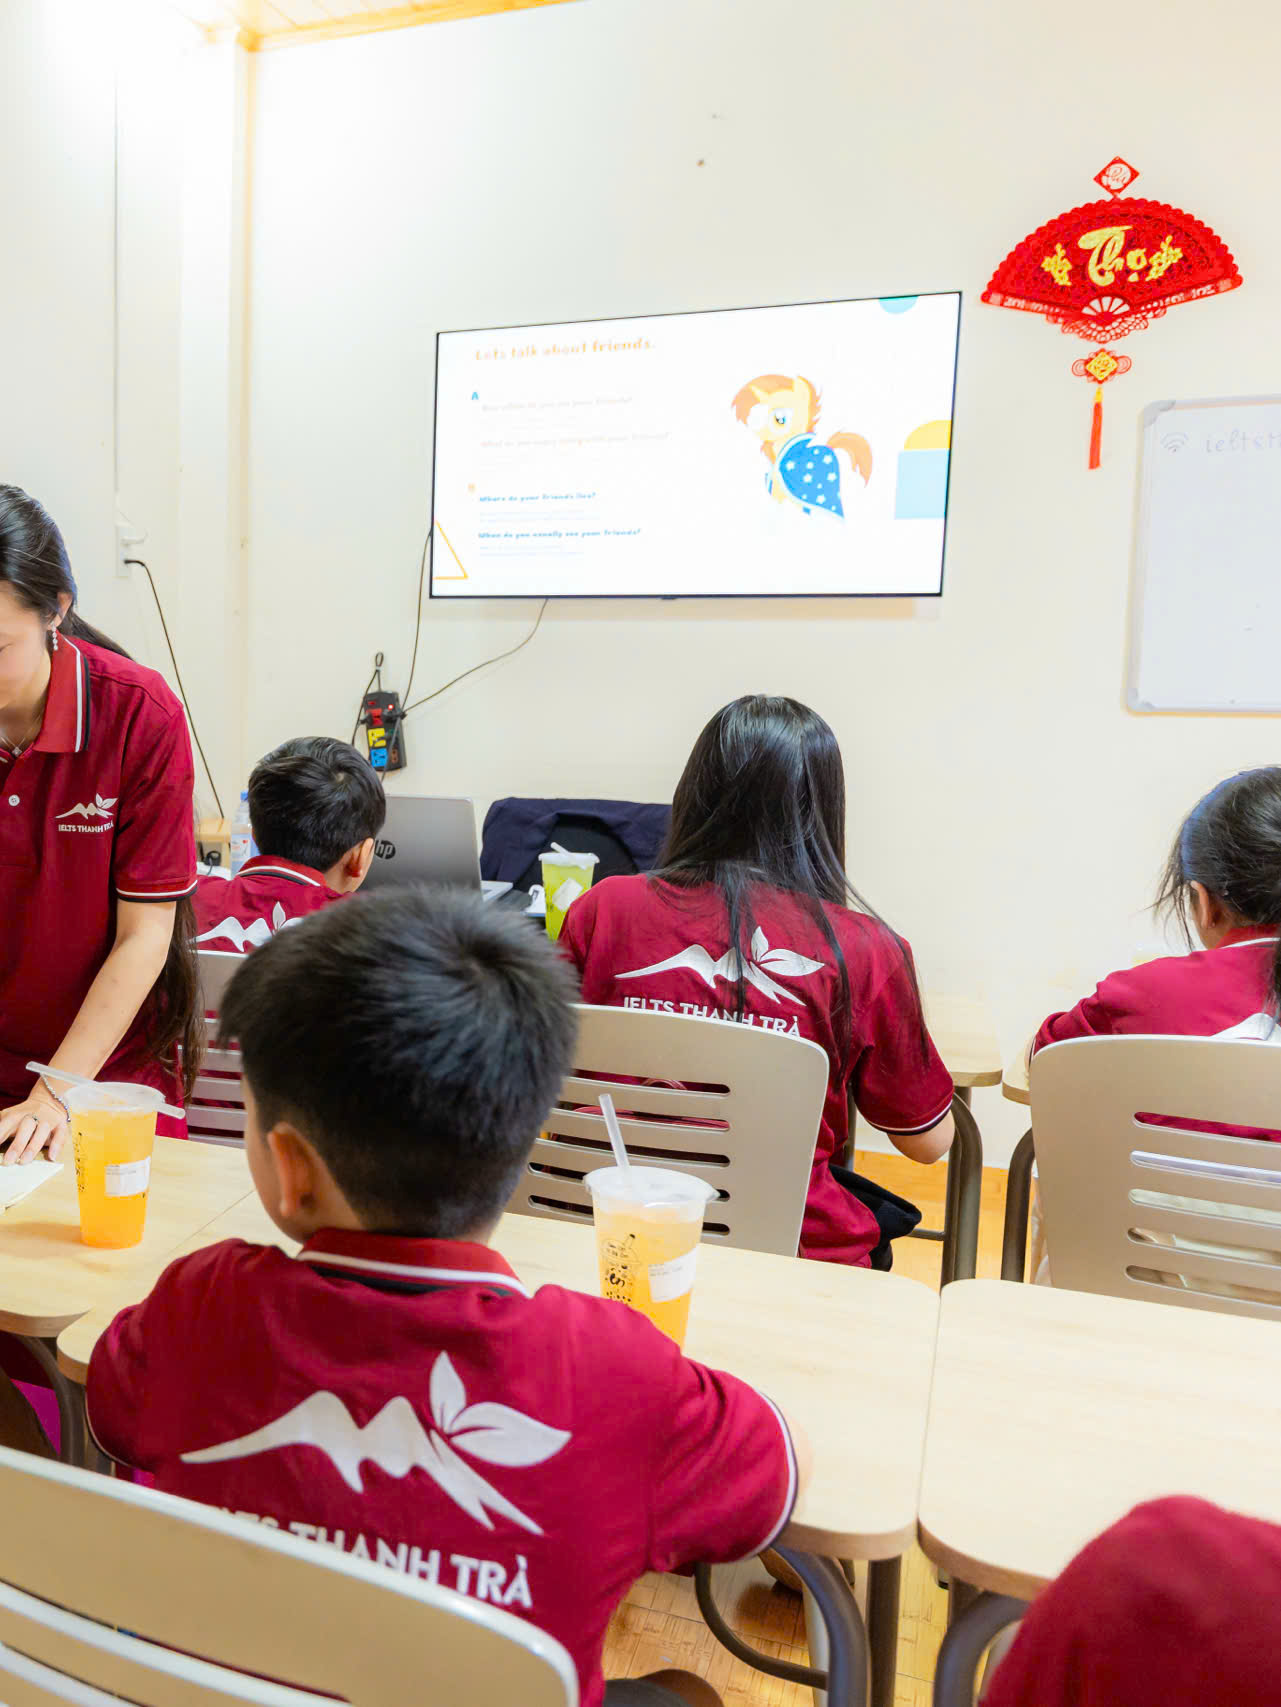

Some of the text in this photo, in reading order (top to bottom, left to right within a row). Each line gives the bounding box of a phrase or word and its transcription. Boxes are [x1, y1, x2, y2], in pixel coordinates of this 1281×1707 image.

[58, 824, 77, 832] IELTS
[77, 825, 104, 833] THANH
[375, 840, 394, 859] hp
[679, 1002, 753, 1026] THANH
[759, 1015, 801, 1037] TRÀ
[450, 1553, 533, 1609] TRÀ
